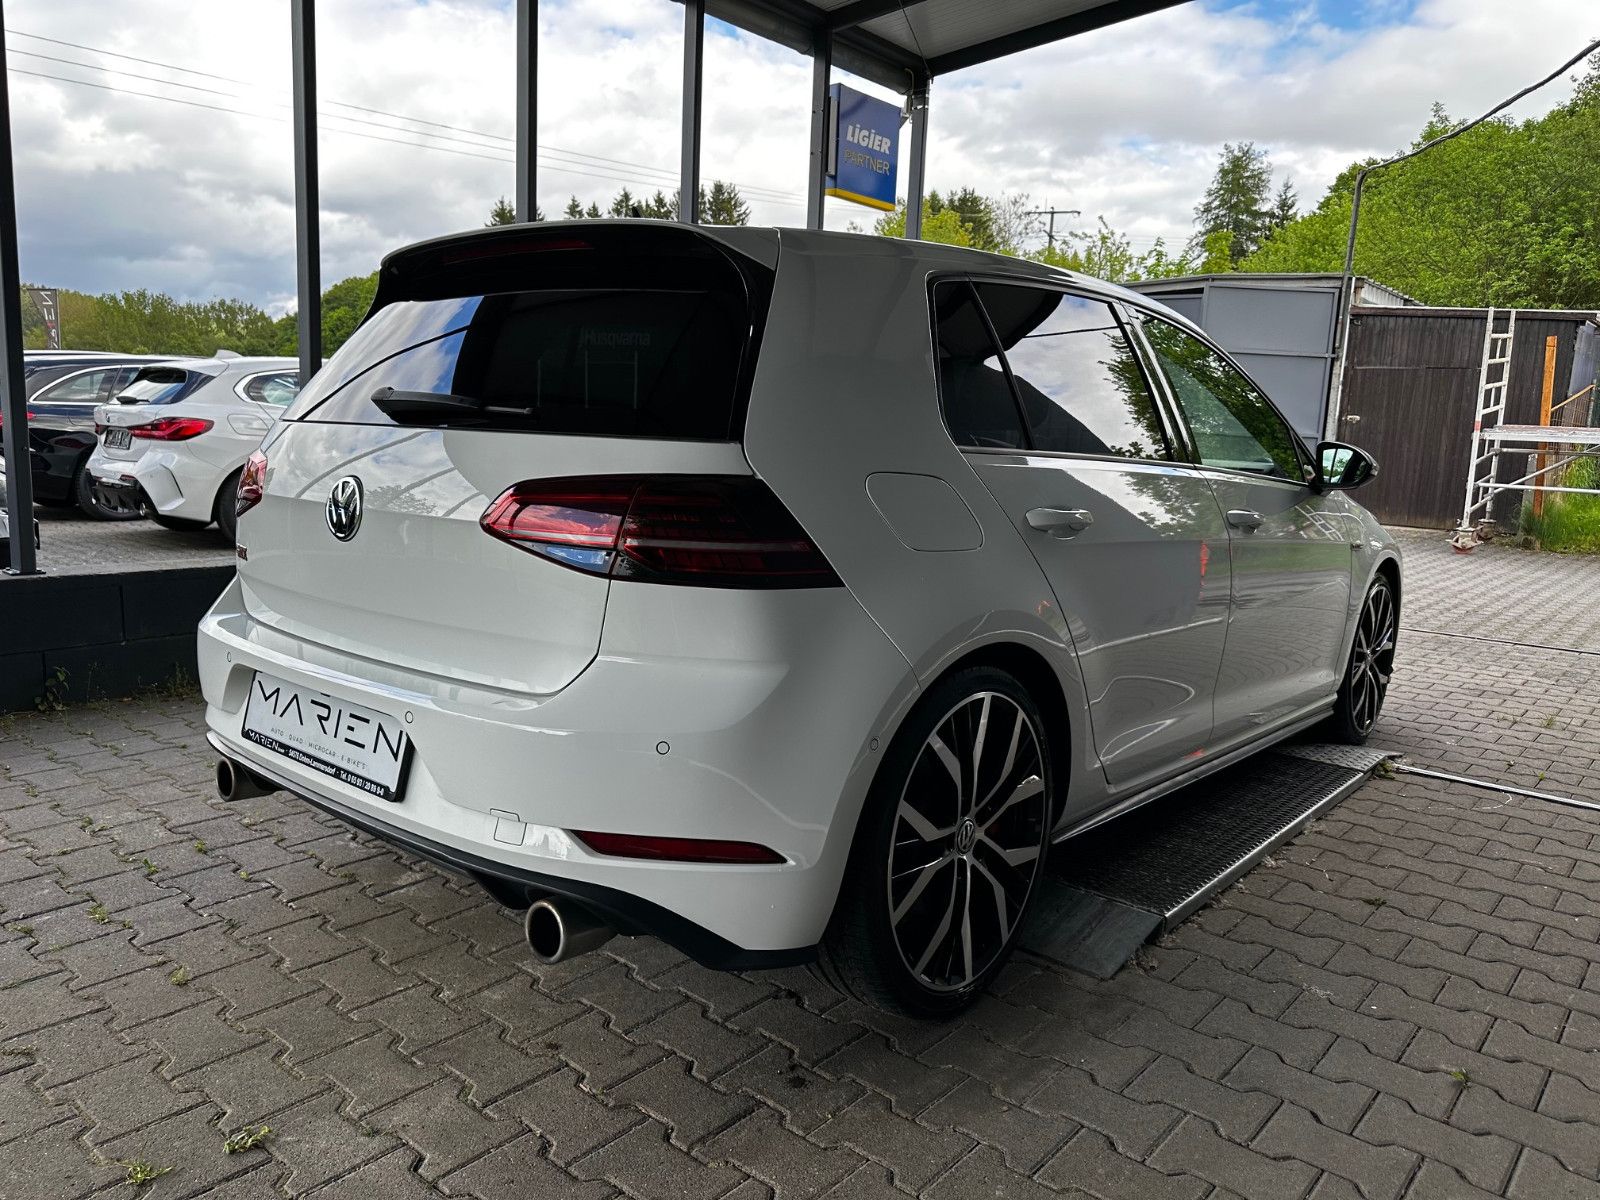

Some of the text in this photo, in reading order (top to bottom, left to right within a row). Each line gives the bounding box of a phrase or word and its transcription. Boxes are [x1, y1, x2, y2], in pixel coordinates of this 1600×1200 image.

[844, 149, 890, 176] PARTNER
[257, 679, 404, 763] MARIEN
[248, 729, 279, 751] MARIEN
[271, 727, 284, 737] AUTO
[289, 733, 303, 744] QUAD
[308, 742, 336, 757] MICROCAR
